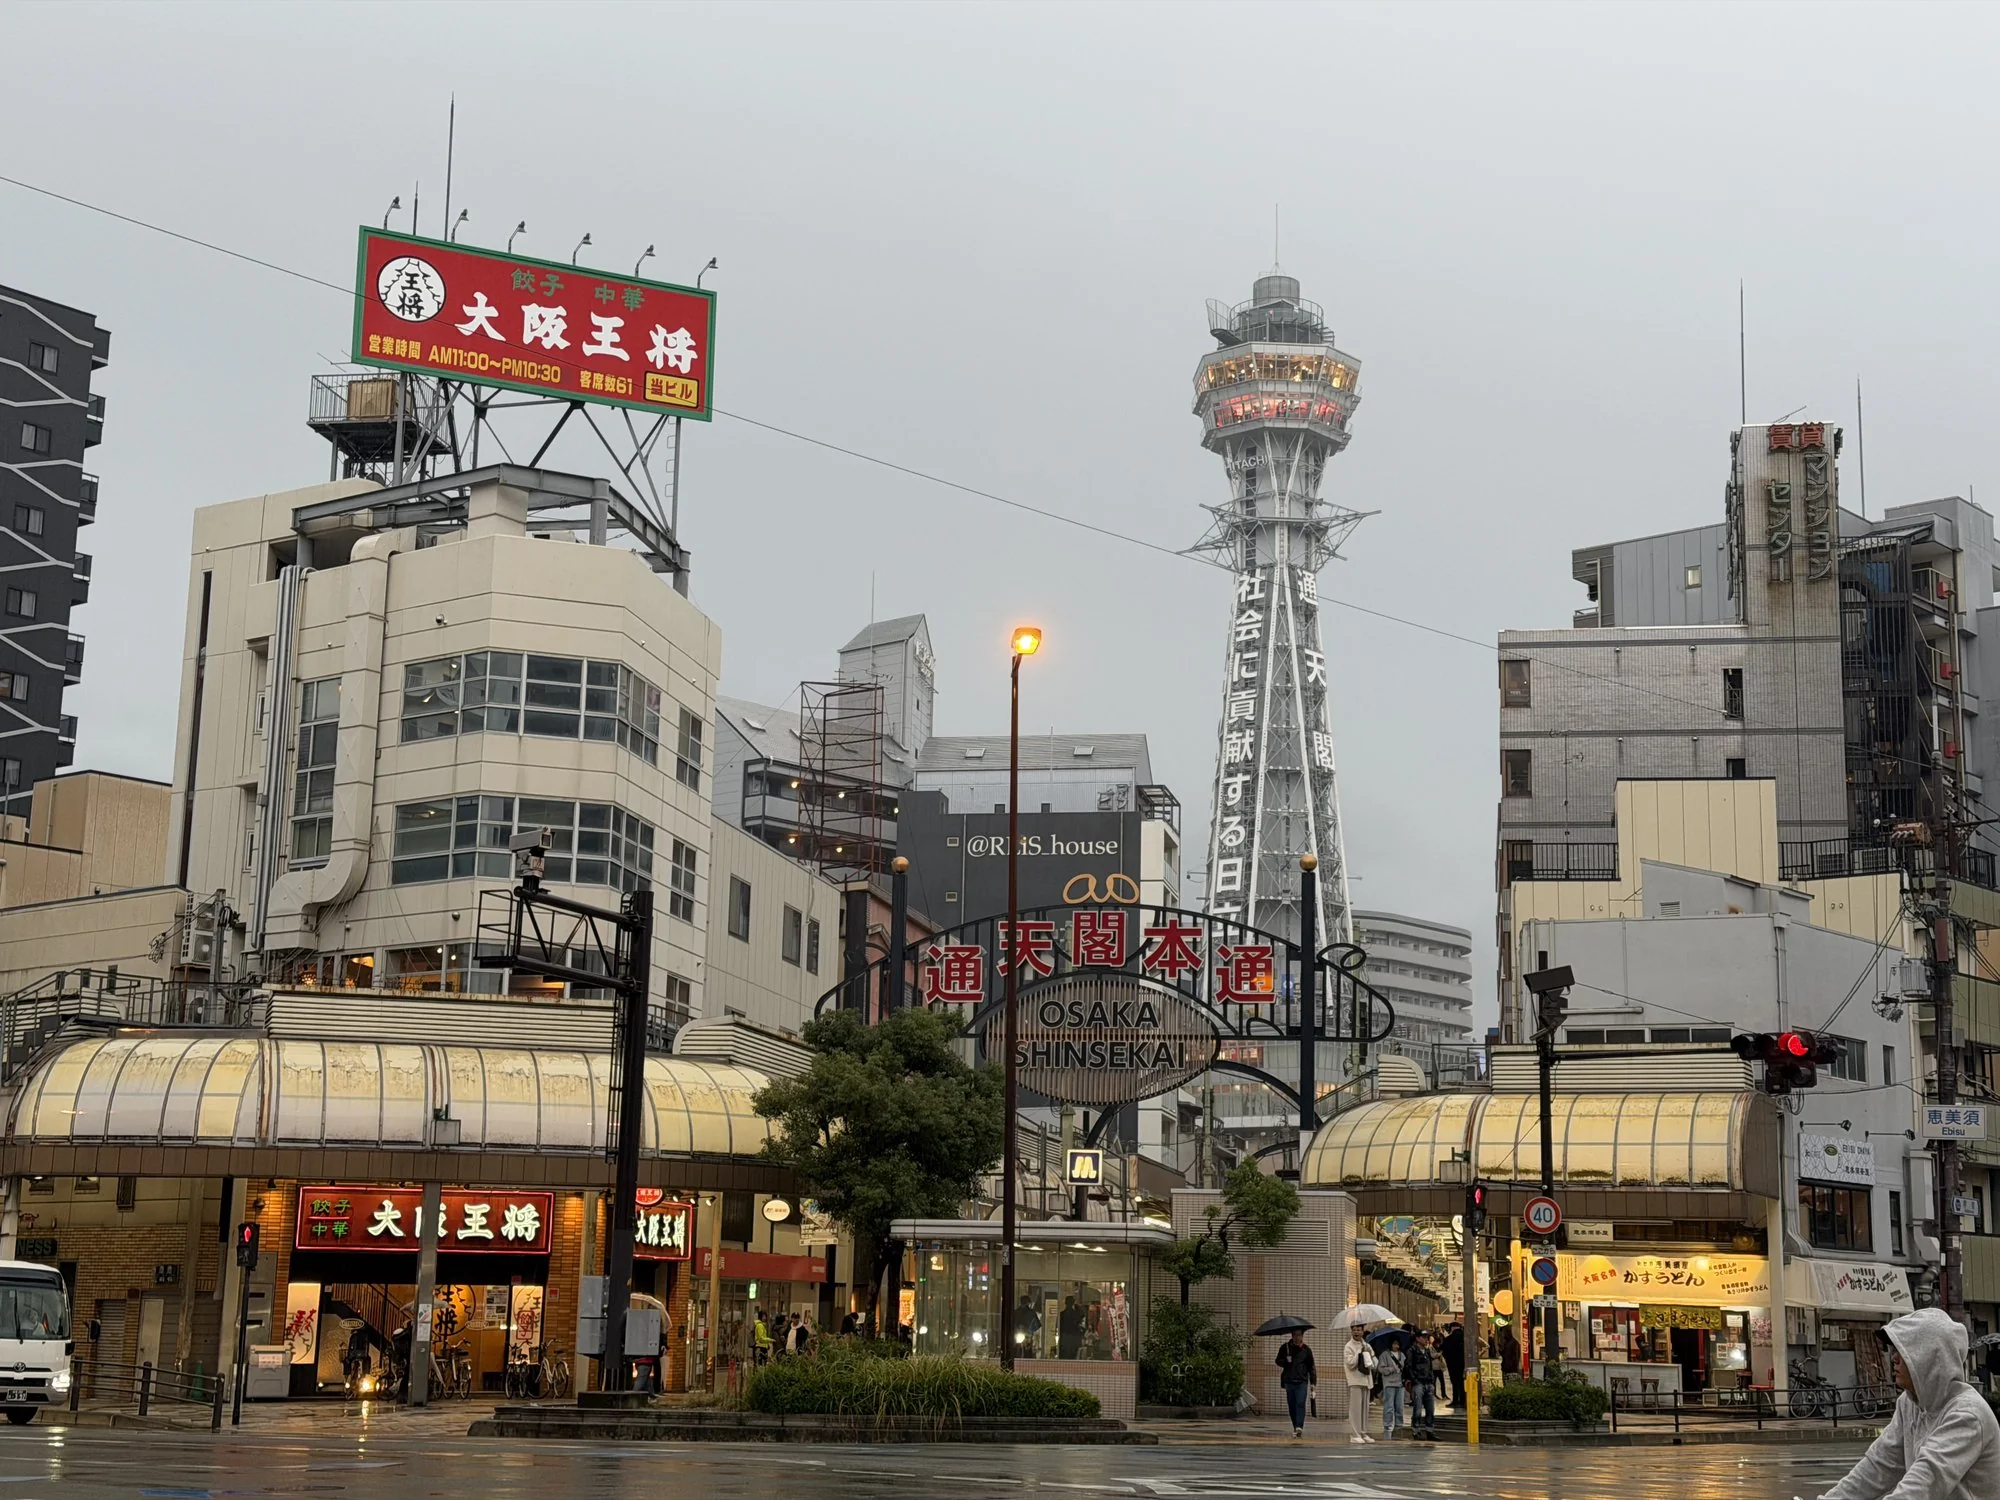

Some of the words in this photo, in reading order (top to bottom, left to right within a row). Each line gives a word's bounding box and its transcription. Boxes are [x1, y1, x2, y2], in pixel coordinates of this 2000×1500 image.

[511, 268, 565, 297] 餃子
[595, 283, 646, 311] 中華
[454, 291, 698, 374] 大阪王将
[368, 334, 422, 360] 営業時間
[579, 369, 633, 396] 客席数61
[650, 376, 693, 401] 当ビル
[1767, 422, 1825, 449] 賃貸
[1764, 479, 1791, 582] センター
[1803, 452, 1832, 580] マンション
[1296, 568, 1336, 771] 通天閣
[925, 910, 1277, 1004] 通天閣本通
[1038, 1000, 1159, 1029] OSAKA
[1015, 1040, 1185, 1070] SHINSEKAI
[1927, 1109, 1981, 1126] 恵美須
[1941, 1127, 1966, 1136] Ebisu
[312, 1199, 351, 1215] 餃子
[1533, 1207, 1553, 1223] 40
[312, 1221, 349, 1237] 中華
[635, 1209, 686, 1256] 大阪王将
[1623, 1270, 1705, 1287] かすうどん
